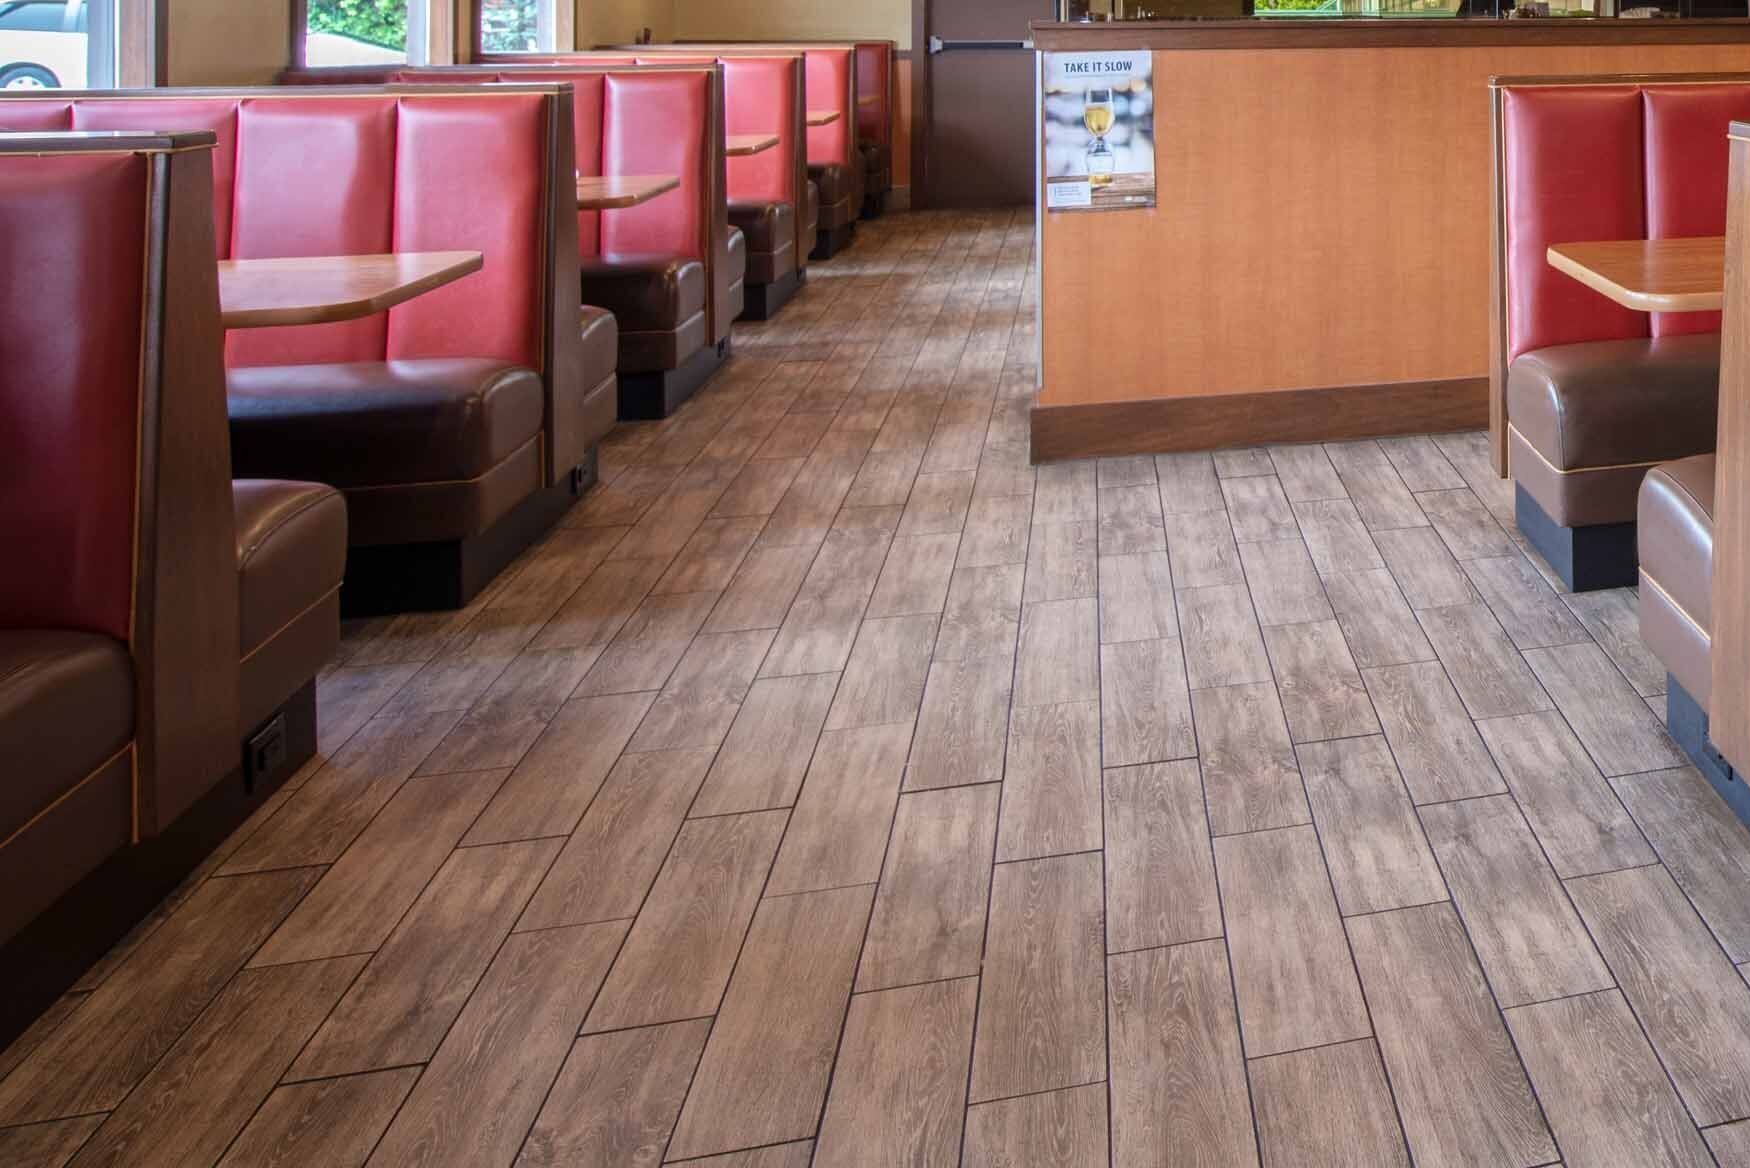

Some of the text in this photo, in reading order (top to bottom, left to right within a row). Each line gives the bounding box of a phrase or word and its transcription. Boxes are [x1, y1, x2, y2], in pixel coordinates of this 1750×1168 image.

[1064, 61, 1132, 72] TAKE IT SLOW
